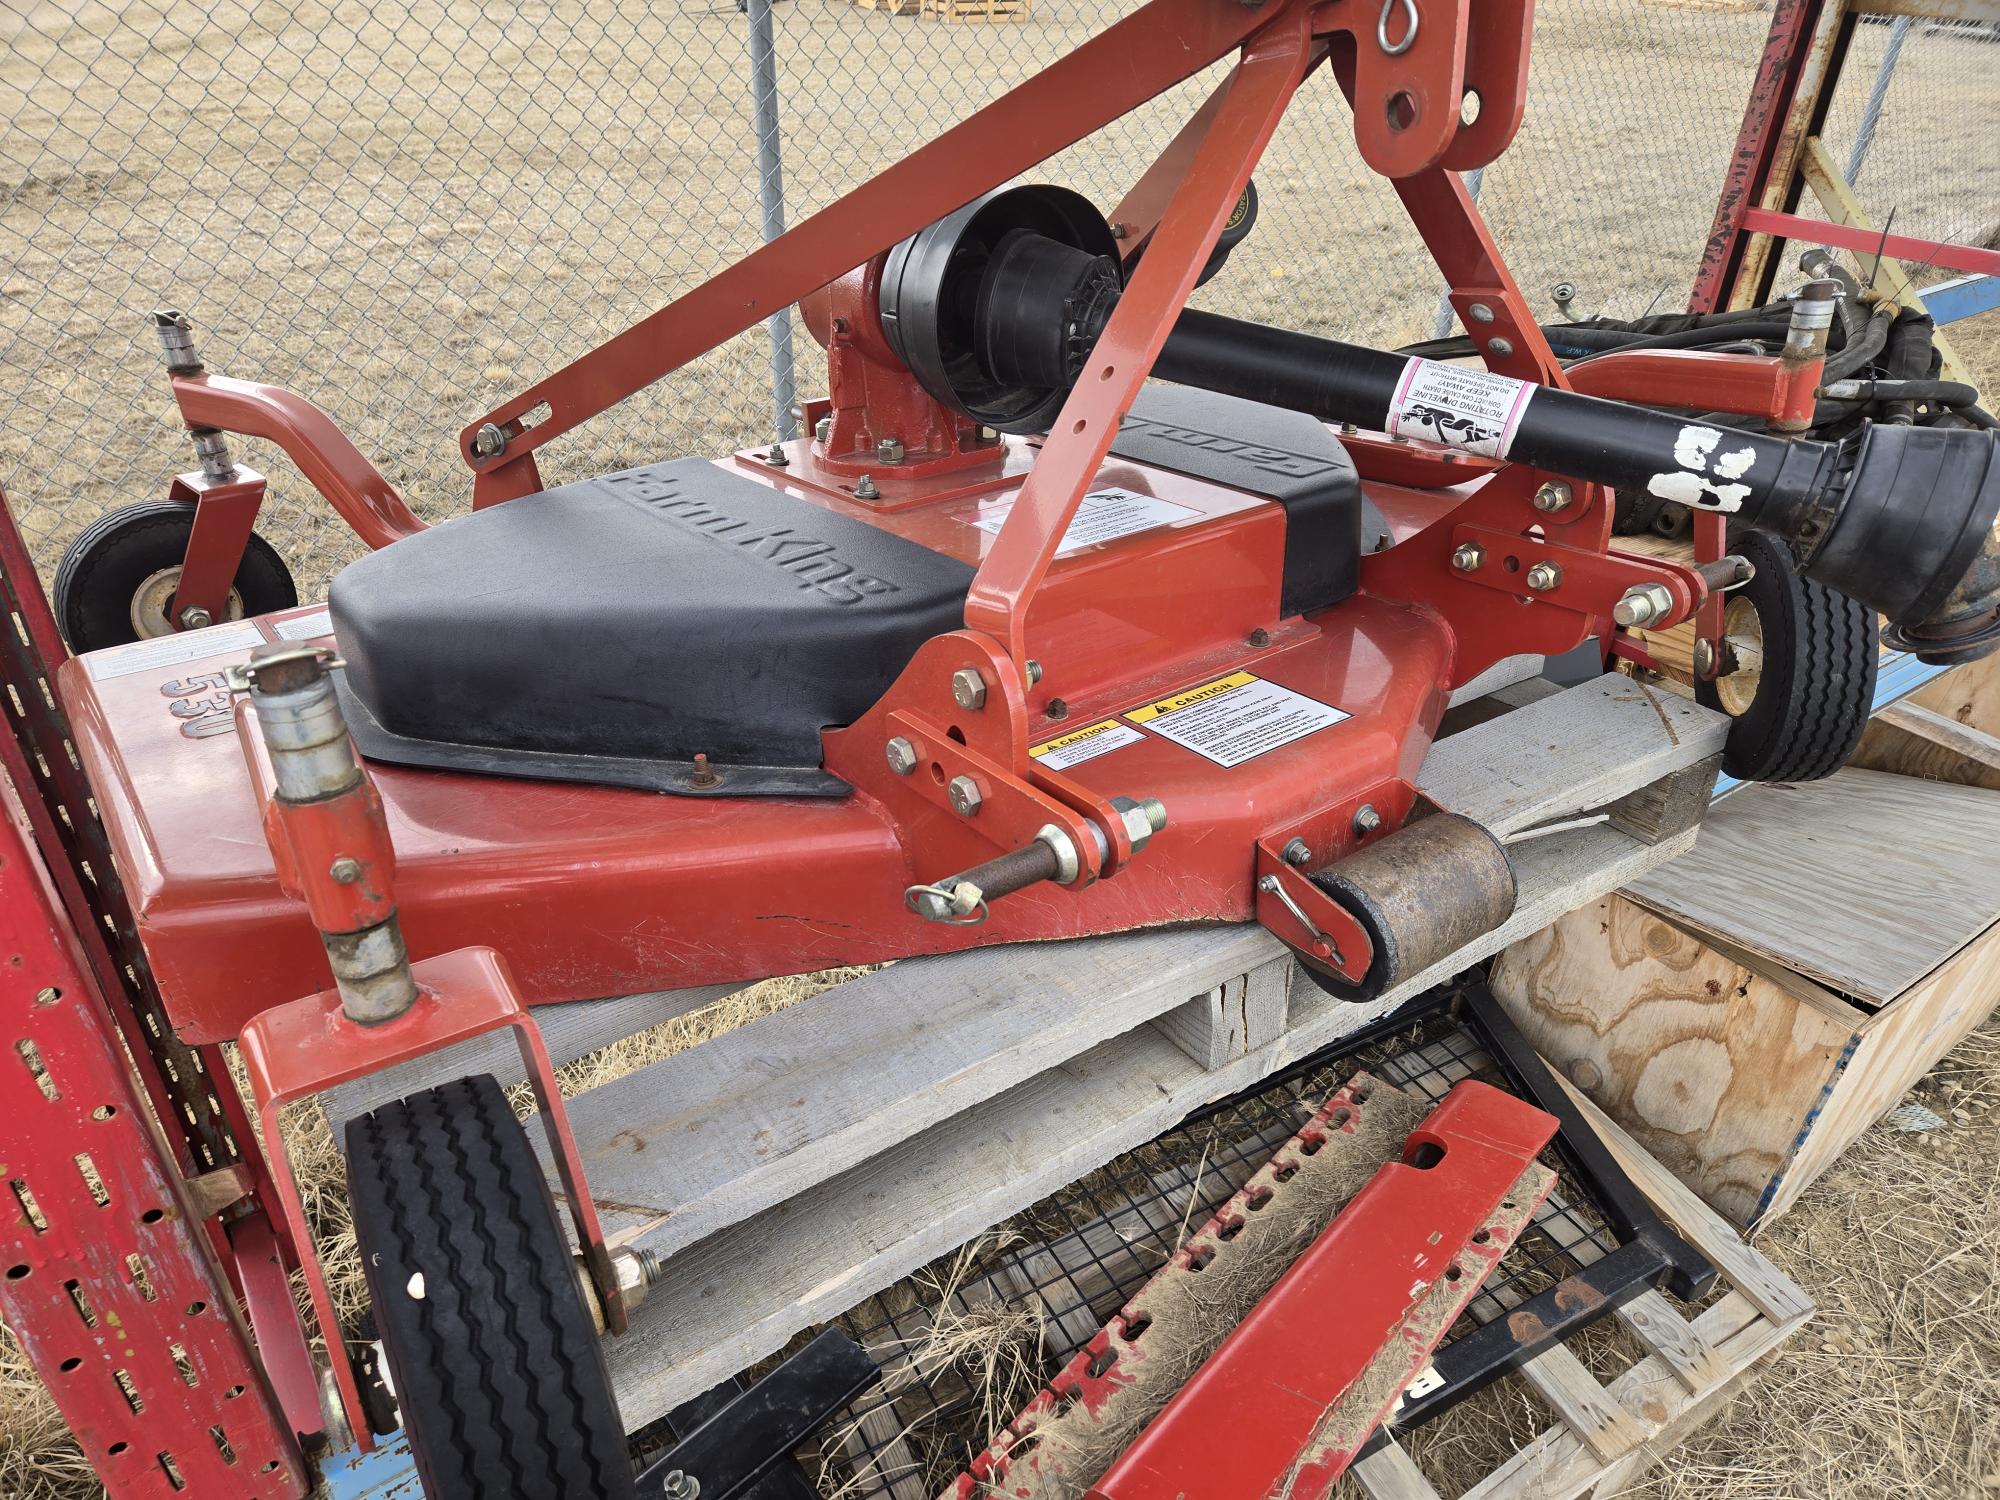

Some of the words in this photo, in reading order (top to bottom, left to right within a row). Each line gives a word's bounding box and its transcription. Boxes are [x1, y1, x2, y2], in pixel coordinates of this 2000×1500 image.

[1227, 191, 1246, 225] RATOR'S
[1430, 372, 1457, 381] WITHOUT
[1458, 378, 1485, 388] OPERATE
[1423, 384, 1441, 393] DEATH
[1438, 380, 1465, 390] AWAY!
[1466, 388, 1490, 397] KEEP
[1413, 390, 1458, 406] DRVELINE
[1459, 402, 1503, 418] ROTATING
[1146, 428, 1340, 478] Farm
[604, 473, 749, 534] Farm
[1176, 684, 1233, 705] CAUTION
[1060, 726, 1109, 745] CAUTION
